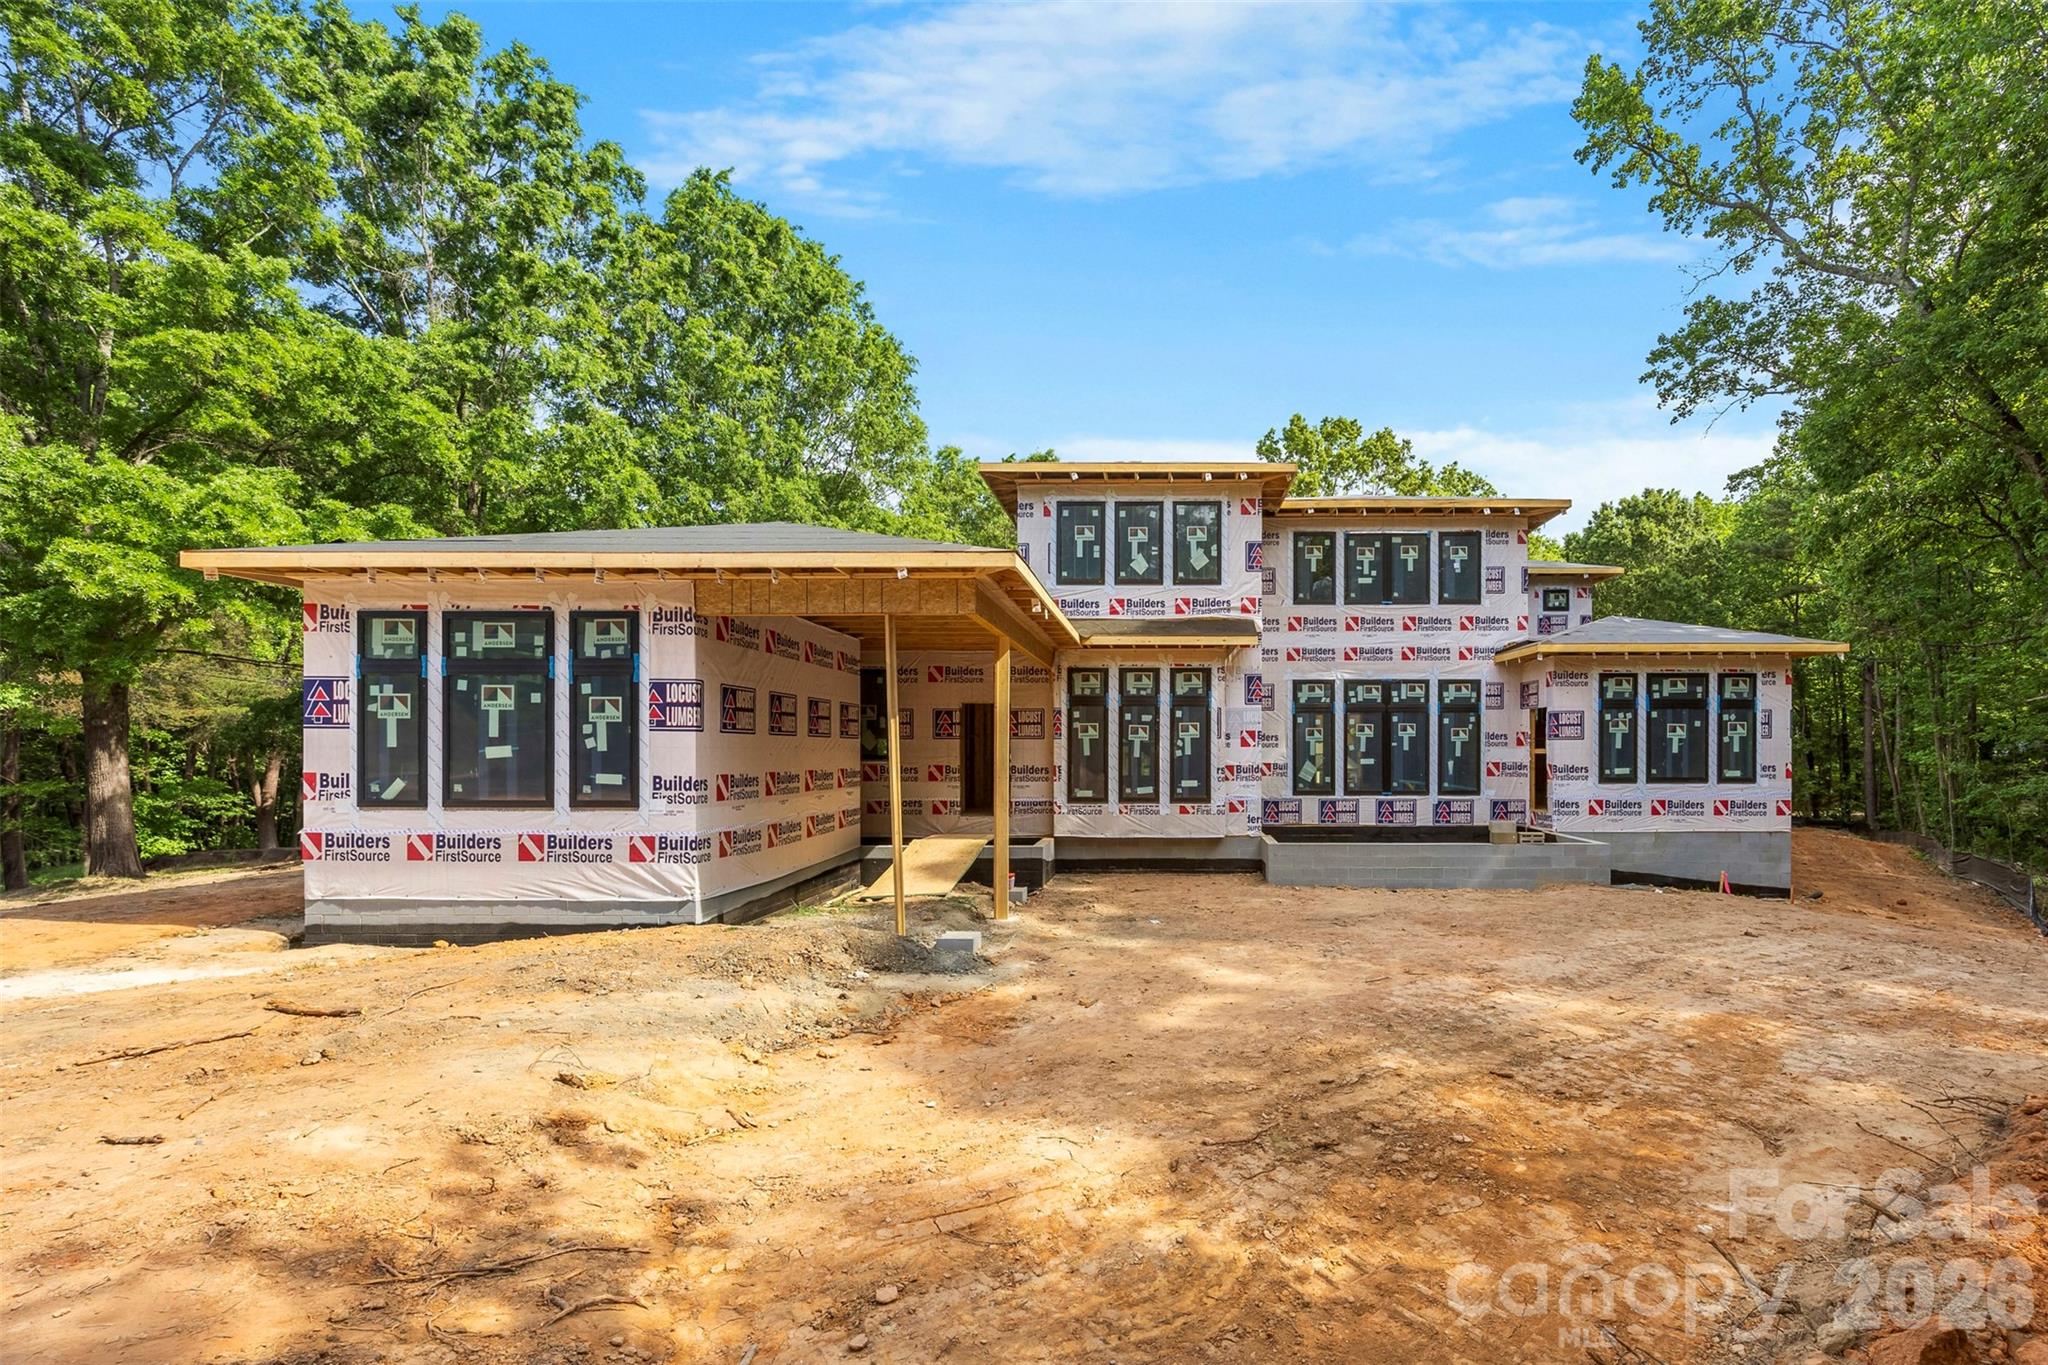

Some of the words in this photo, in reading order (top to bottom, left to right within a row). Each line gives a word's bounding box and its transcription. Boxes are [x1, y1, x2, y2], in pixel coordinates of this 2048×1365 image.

[1060, 599, 1100, 609] Builders
[1126, 598, 1166, 608] Builders
[1192, 598, 1231, 608] Builders
[320, 604, 350, 619] Buil
[652, 606, 709, 625] Builders
[1126, 608, 1166, 616] FirstSource
[1303, 616, 1337, 626] Builders
[1360, 616, 1394, 626] Builders
[1417, 616, 1452, 626] Builders
[1475, 616, 1509, 625] Builders
[319, 620, 351, 633] FirstS
[652, 623, 709, 638] FirstSource
[730, 618, 760, 640] Builders
[776, 632, 800, 651] Builders
[1301, 647, 1336, 656] Builders
[1359, 646, 1393, 656] Builders
[1416, 646, 1451, 655] Builders
[945, 666, 984, 677] Builders
[1010, 666, 1049, 677] Builders
[1552, 671, 1589, 680] Builders
[945, 676, 984, 684] FirstSource
[1010, 676, 1049, 684] FirstSource
[333, 681, 350, 700] LOC
[666, 683, 703, 704] LOCUST
[666, 706, 703, 727] LUMBER
[1018, 711, 1042, 723] LOCUST
[1559, 713, 1582, 724] LOCUST
[1018, 724, 1042, 736] LUMBER
[1559, 726, 1582, 737] LUMBER
[1010, 765, 1049, 775] Builders
[1553, 764, 1589, 774] Builders
[320, 773, 350, 789] Buil
[730, 773, 759, 789] Builders
[776, 772, 800, 786] Builders
[814, 769, 834, 782] Builders
[1010, 775, 1049, 783] FirstSource
[1553, 773, 1589, 782] FirstSource
[653, 776, 709, 792] Builders
[729, 787, 759, 801] FirstSource
[1336, 801, 1356, 811] LOCUST
[1393, 801, 1414, 811] LOCUST
[1451, 801, 1471, 811] LOCUST
[1604, 800, 1642, 809] Builders
[1667, 800, 1705, 809] Builders
[1730, 800, 1768, 809] Builders
[1014, 807, 1054, 815] FirstSource
[1604, 809, 1642, 817] FirstSource
[1667, 809, 1705, 817] FirstSource
[1729, 809, 1768, 817] FirstSource
[815, 813, 835, 827] Builders
[778, 820, 801, 836] Builders
[325, 833, 390, 849] Builders
[436, 834, 502, 849] Builders
[547, 834, 613, 850] Builders
[732, 829, 762, 845] Builders
[658, 835, 711, 851] Builders
[732, 842, 762, 857] FirstSource
[324, 849, 390, 862] FirstSource
[435, 849, 502, 863] FirstSource
[547, 850, 613, 863] FirstSource
[657, 850, 711, 864] FirstSource
